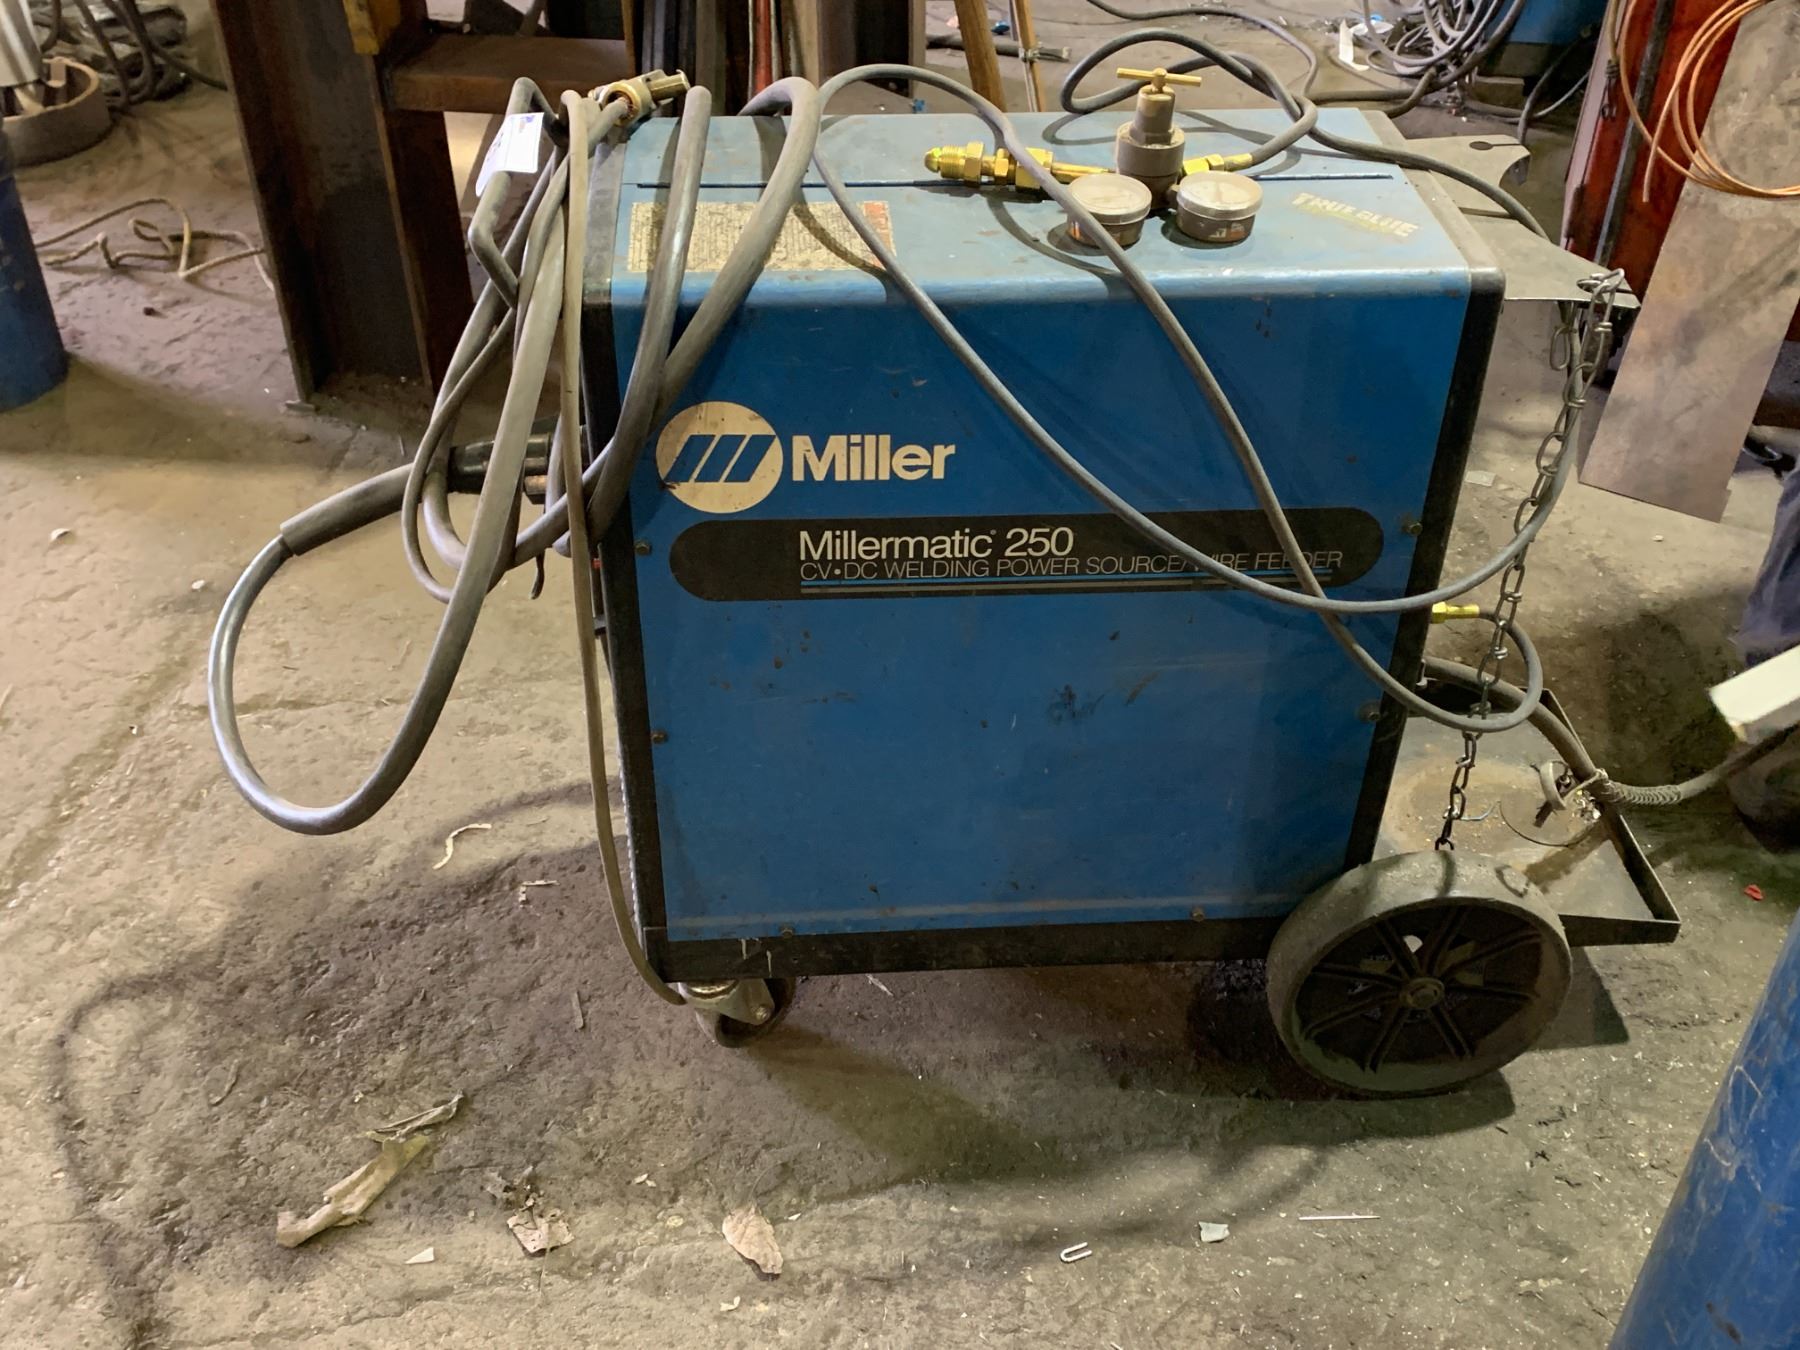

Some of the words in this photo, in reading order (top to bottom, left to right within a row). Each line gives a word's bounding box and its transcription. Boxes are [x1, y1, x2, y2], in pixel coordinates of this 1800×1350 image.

[792, 434, 956, 482] Miller
[1004, 526, 1074, 557] 250
[883, 558, 990, 579] WELDING
[996, 556, 1080, 577] POWER
